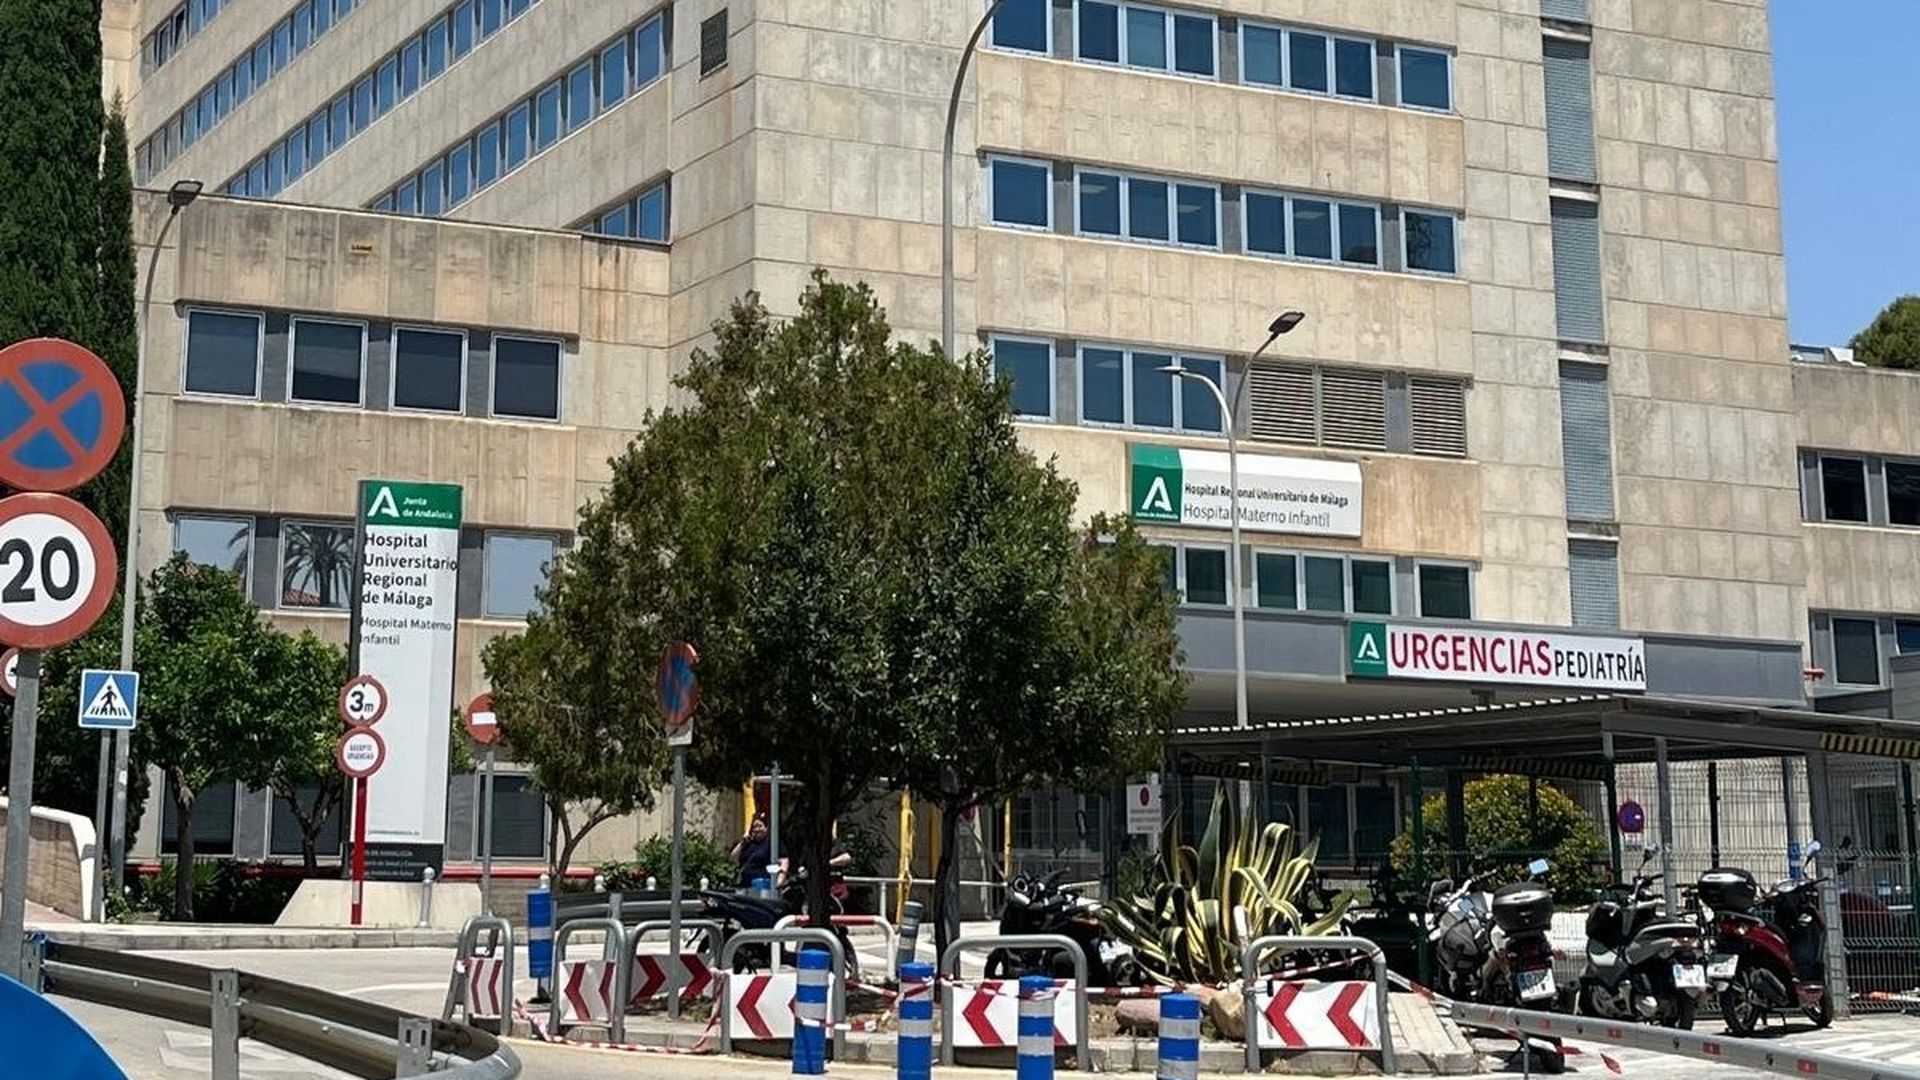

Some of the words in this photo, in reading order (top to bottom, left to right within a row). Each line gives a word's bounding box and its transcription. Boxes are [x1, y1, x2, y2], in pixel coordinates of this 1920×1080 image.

[402, 496, 428, 506] Junta
[1185, 483, 1219, 496] Hospital
[1220, 485, 1255, 499] Reonal
[1256, 487, 1308, 503] Universitario
[1309, 492, 1319, 504] de
[402, 508, 413, 517] de
[1237, 506, 1287, 524] Materno
[1288, 510, 1331, 528] Infantil
[364, 533, 428, 550] Hospital
[0, 536, 79, 604] 20
[363, 553, 459, 571] Universitario
[361, 572, 427, 589] Regional
[361, 591, 380, 604] de
[383, 590, 433, 609] Málaga
[360, 616, 408, 629] Hospital
[410, 619, 452, 631] Materno
[1390, 632, 1552, 676] URGENCIAS
[1554, 646, 1645, 682] PEDIATRÍA
